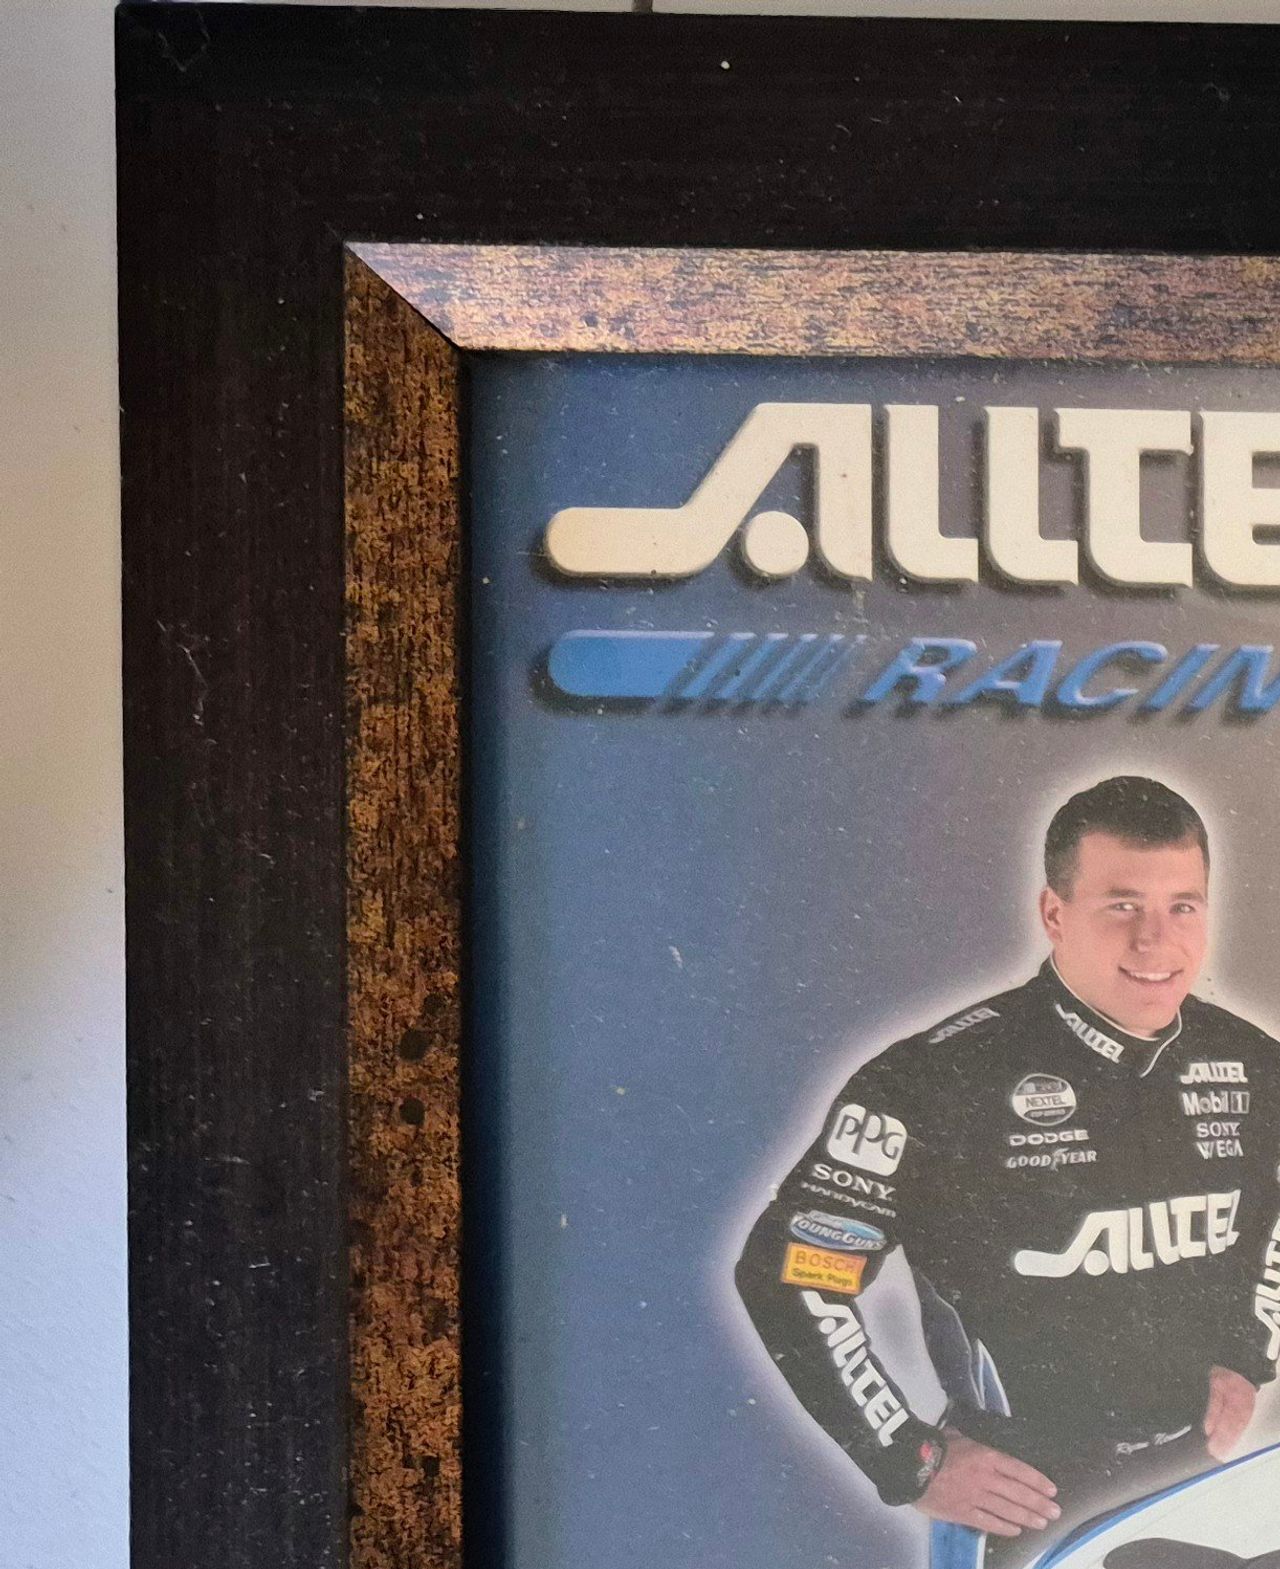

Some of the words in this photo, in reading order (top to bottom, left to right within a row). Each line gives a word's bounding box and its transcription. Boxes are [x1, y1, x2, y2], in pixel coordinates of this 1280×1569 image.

[1181, 1090, 1229, 1116] Mobil
[834, 1112, 904, 1161] PPG
[1009, 1129, 1090, 1147] DODGE
[1195, 1122, 1241, 1138] SONY
[811, 1162, 897, 1203] SONY
[1014, 1190, 1242, 1278] ALLTEL
[795, 1249, 858, 1275] BOSCH
[801, 1291, 909, 1447] ALLTEL
